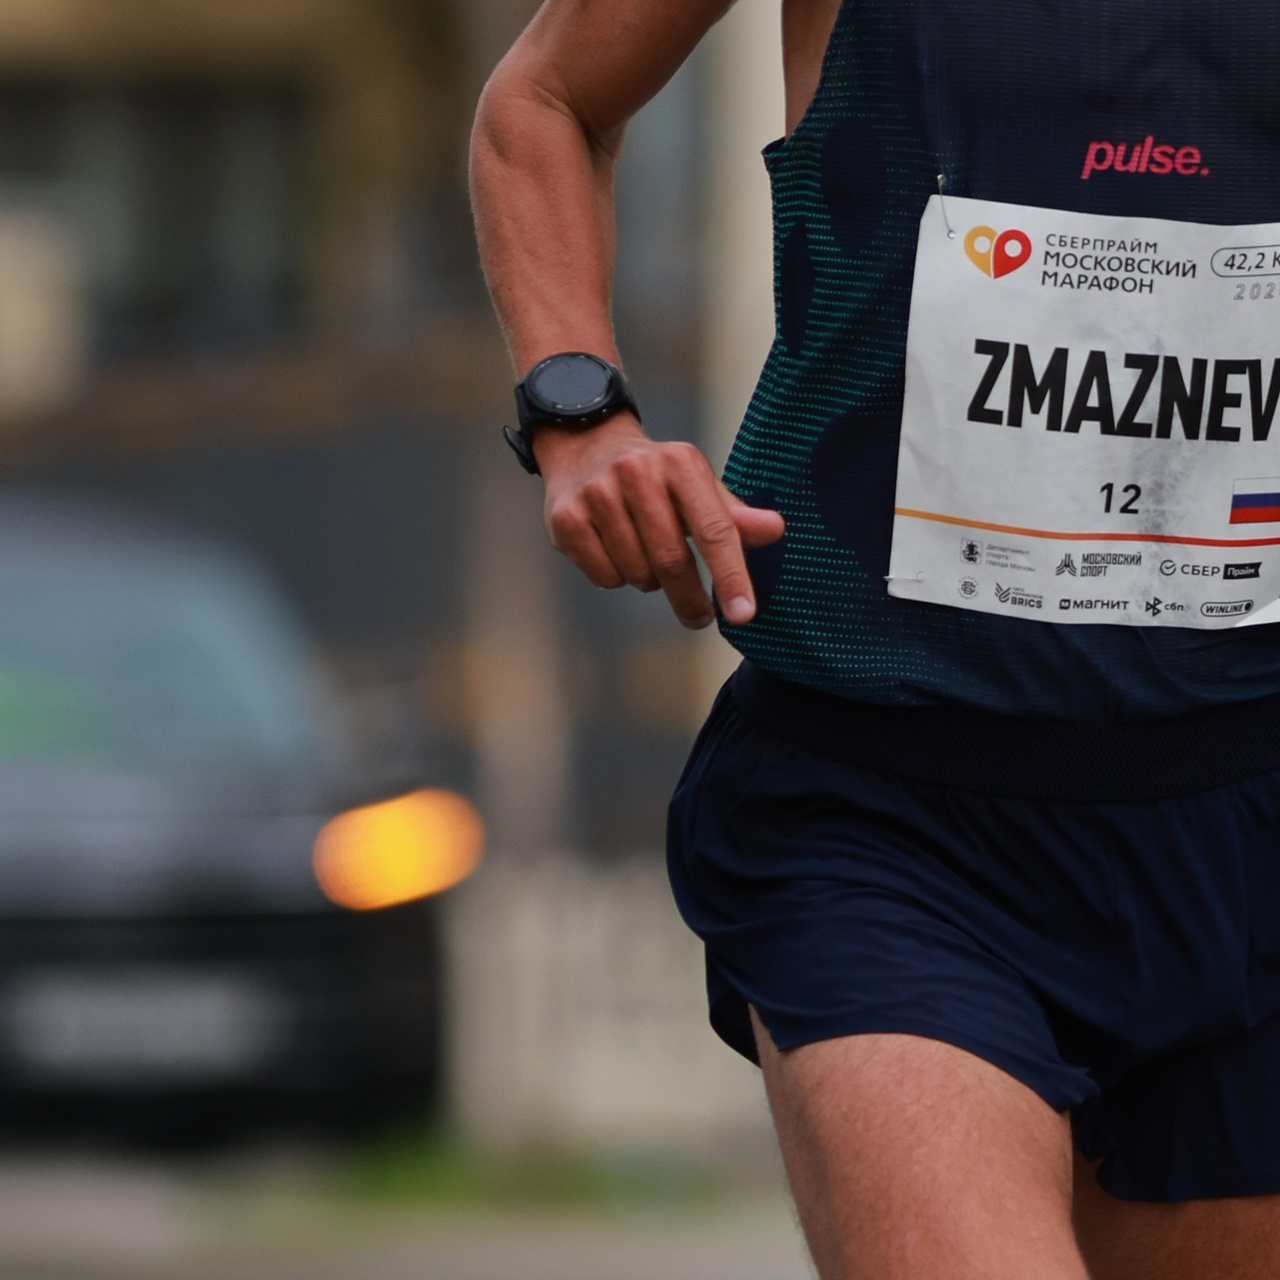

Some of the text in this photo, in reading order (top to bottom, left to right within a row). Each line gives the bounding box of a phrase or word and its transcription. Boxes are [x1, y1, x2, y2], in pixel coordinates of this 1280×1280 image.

[1081, 135, 1209, 180] pulse.
[1046, 233, 1158, 254] СБЕРПРАЙМ
[1043, 250, 1198, 279] МОСКОВСКИЙ
[1223, 253, 1266, 272] 42,2
[1041, 271, 1155, 295] МАРАФОН
[1099, 482, 1143, 515] 12
[1081, 552, 1142, 566] МОСКОВСКИЙ
[1080, 565, 1108, 578] СПОРТ
[1180, 564, 1221, 577] СБЕР
[1011, 597, 1043, 609] BRICS
[1205, 603, 1244, 614] WINLINE
